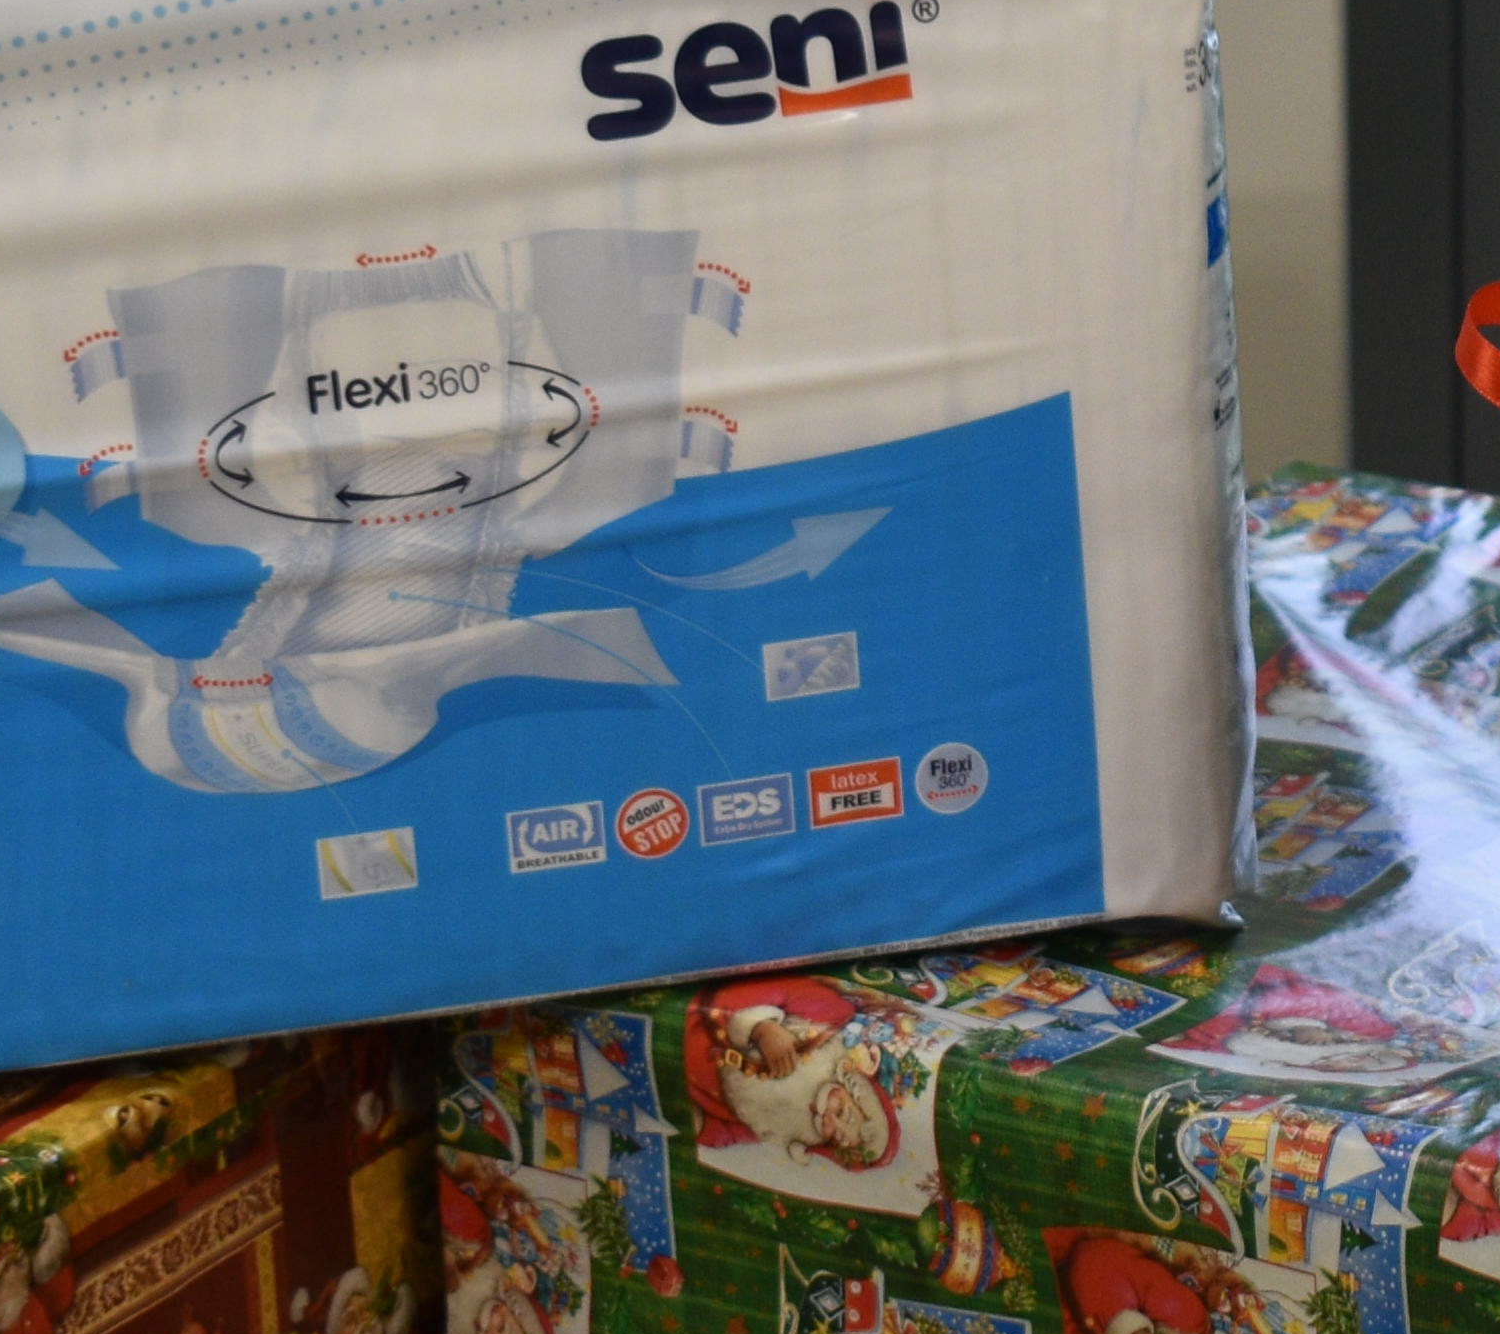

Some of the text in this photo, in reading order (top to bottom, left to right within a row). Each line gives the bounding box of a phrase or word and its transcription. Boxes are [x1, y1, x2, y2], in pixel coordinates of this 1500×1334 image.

[307, 362, 490, 415] Flexi 360°
[929, 753, 974, 778] Flexi
[829, 769, 880, 791] latex
[624, 796, 667, 828] odour
[711, 787, 782, 821] EDS
[829, 788, 882, 811] FREE
[530, 820, 580, 846] AIR
[631, 812, 684, 854] STOP
[515, 849, 601, 871] BREATHABLE
